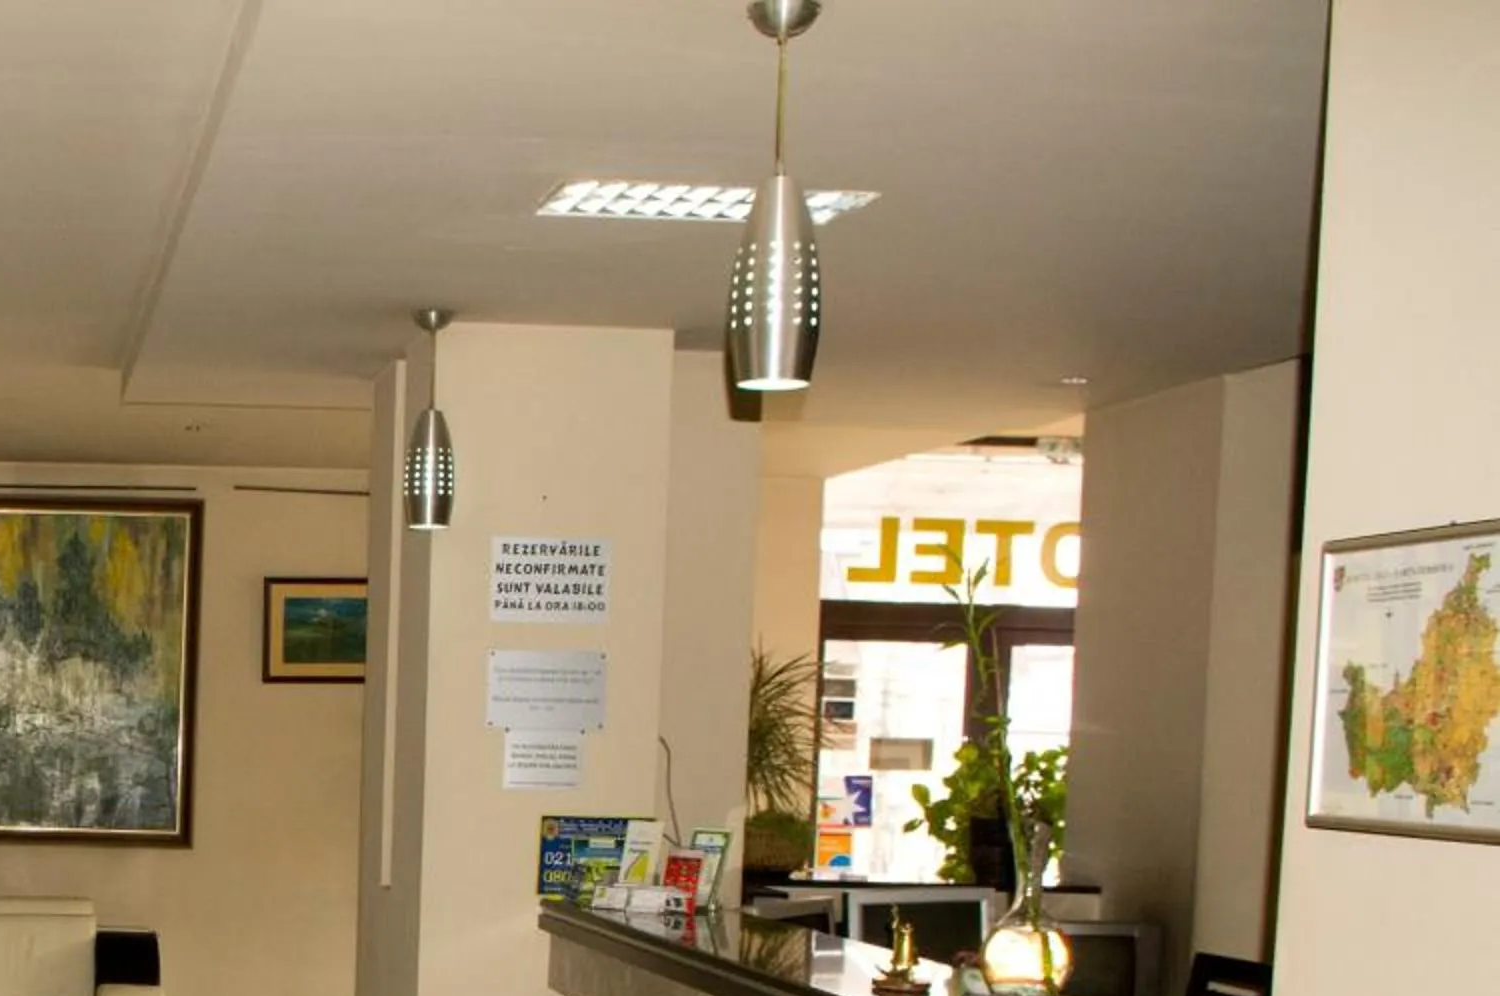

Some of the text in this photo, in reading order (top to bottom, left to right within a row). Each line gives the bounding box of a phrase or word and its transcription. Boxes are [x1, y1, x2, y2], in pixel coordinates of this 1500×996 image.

[495, 563, 605, 577] NECONFIRMATE
[496, 582, 603, 595] SUNT VALABILE
[527, 601, 542, 611] LA
[545, 601, 570, 611] ORA
